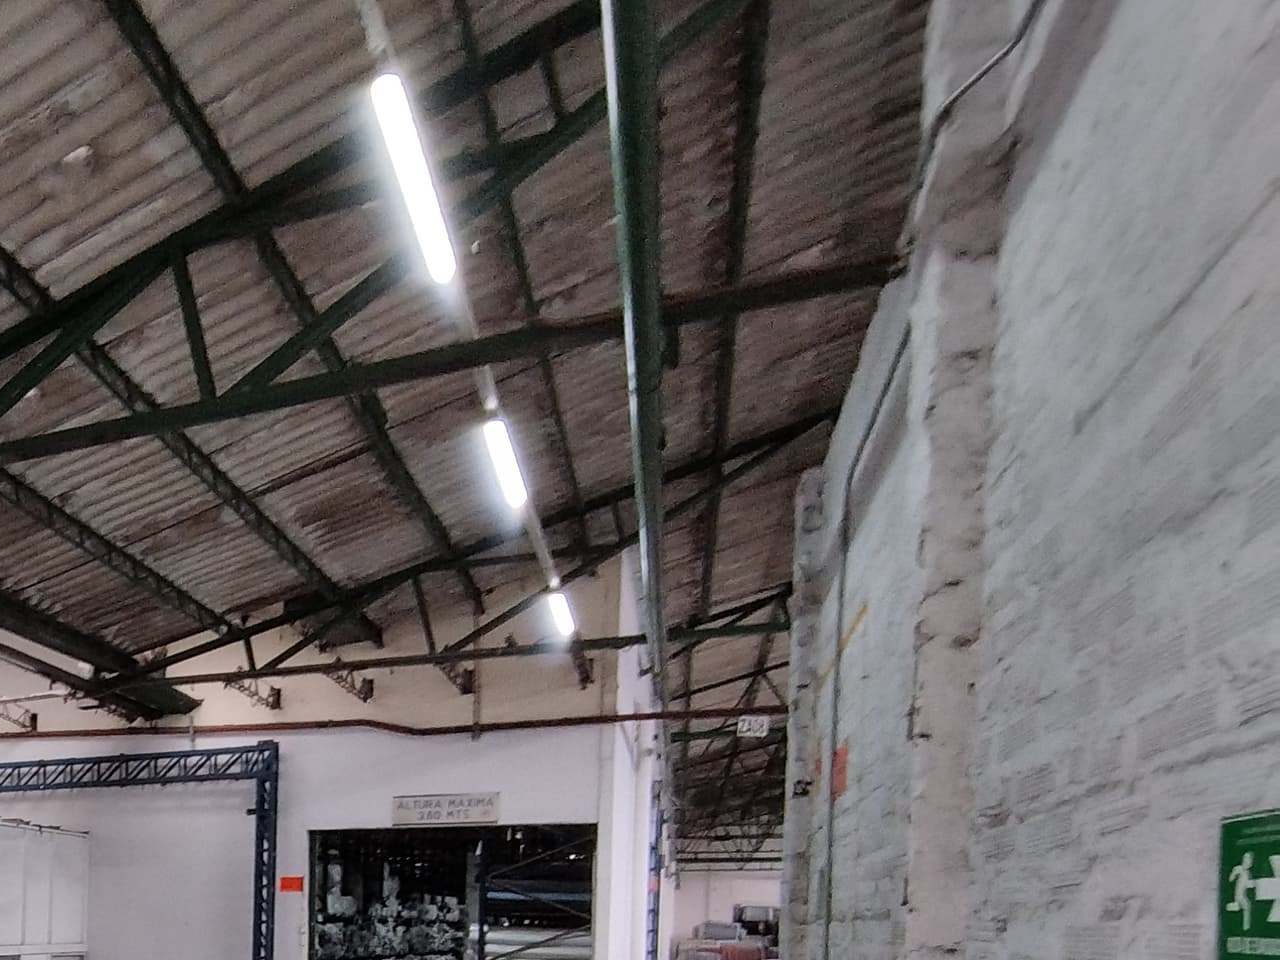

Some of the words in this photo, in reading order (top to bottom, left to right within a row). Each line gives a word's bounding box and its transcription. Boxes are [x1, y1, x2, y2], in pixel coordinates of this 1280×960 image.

[397, 799, 441, 810] ALTURA
[447, 798, 494, 809] MAXIMA
[447, 808, 470, 819] MTS
